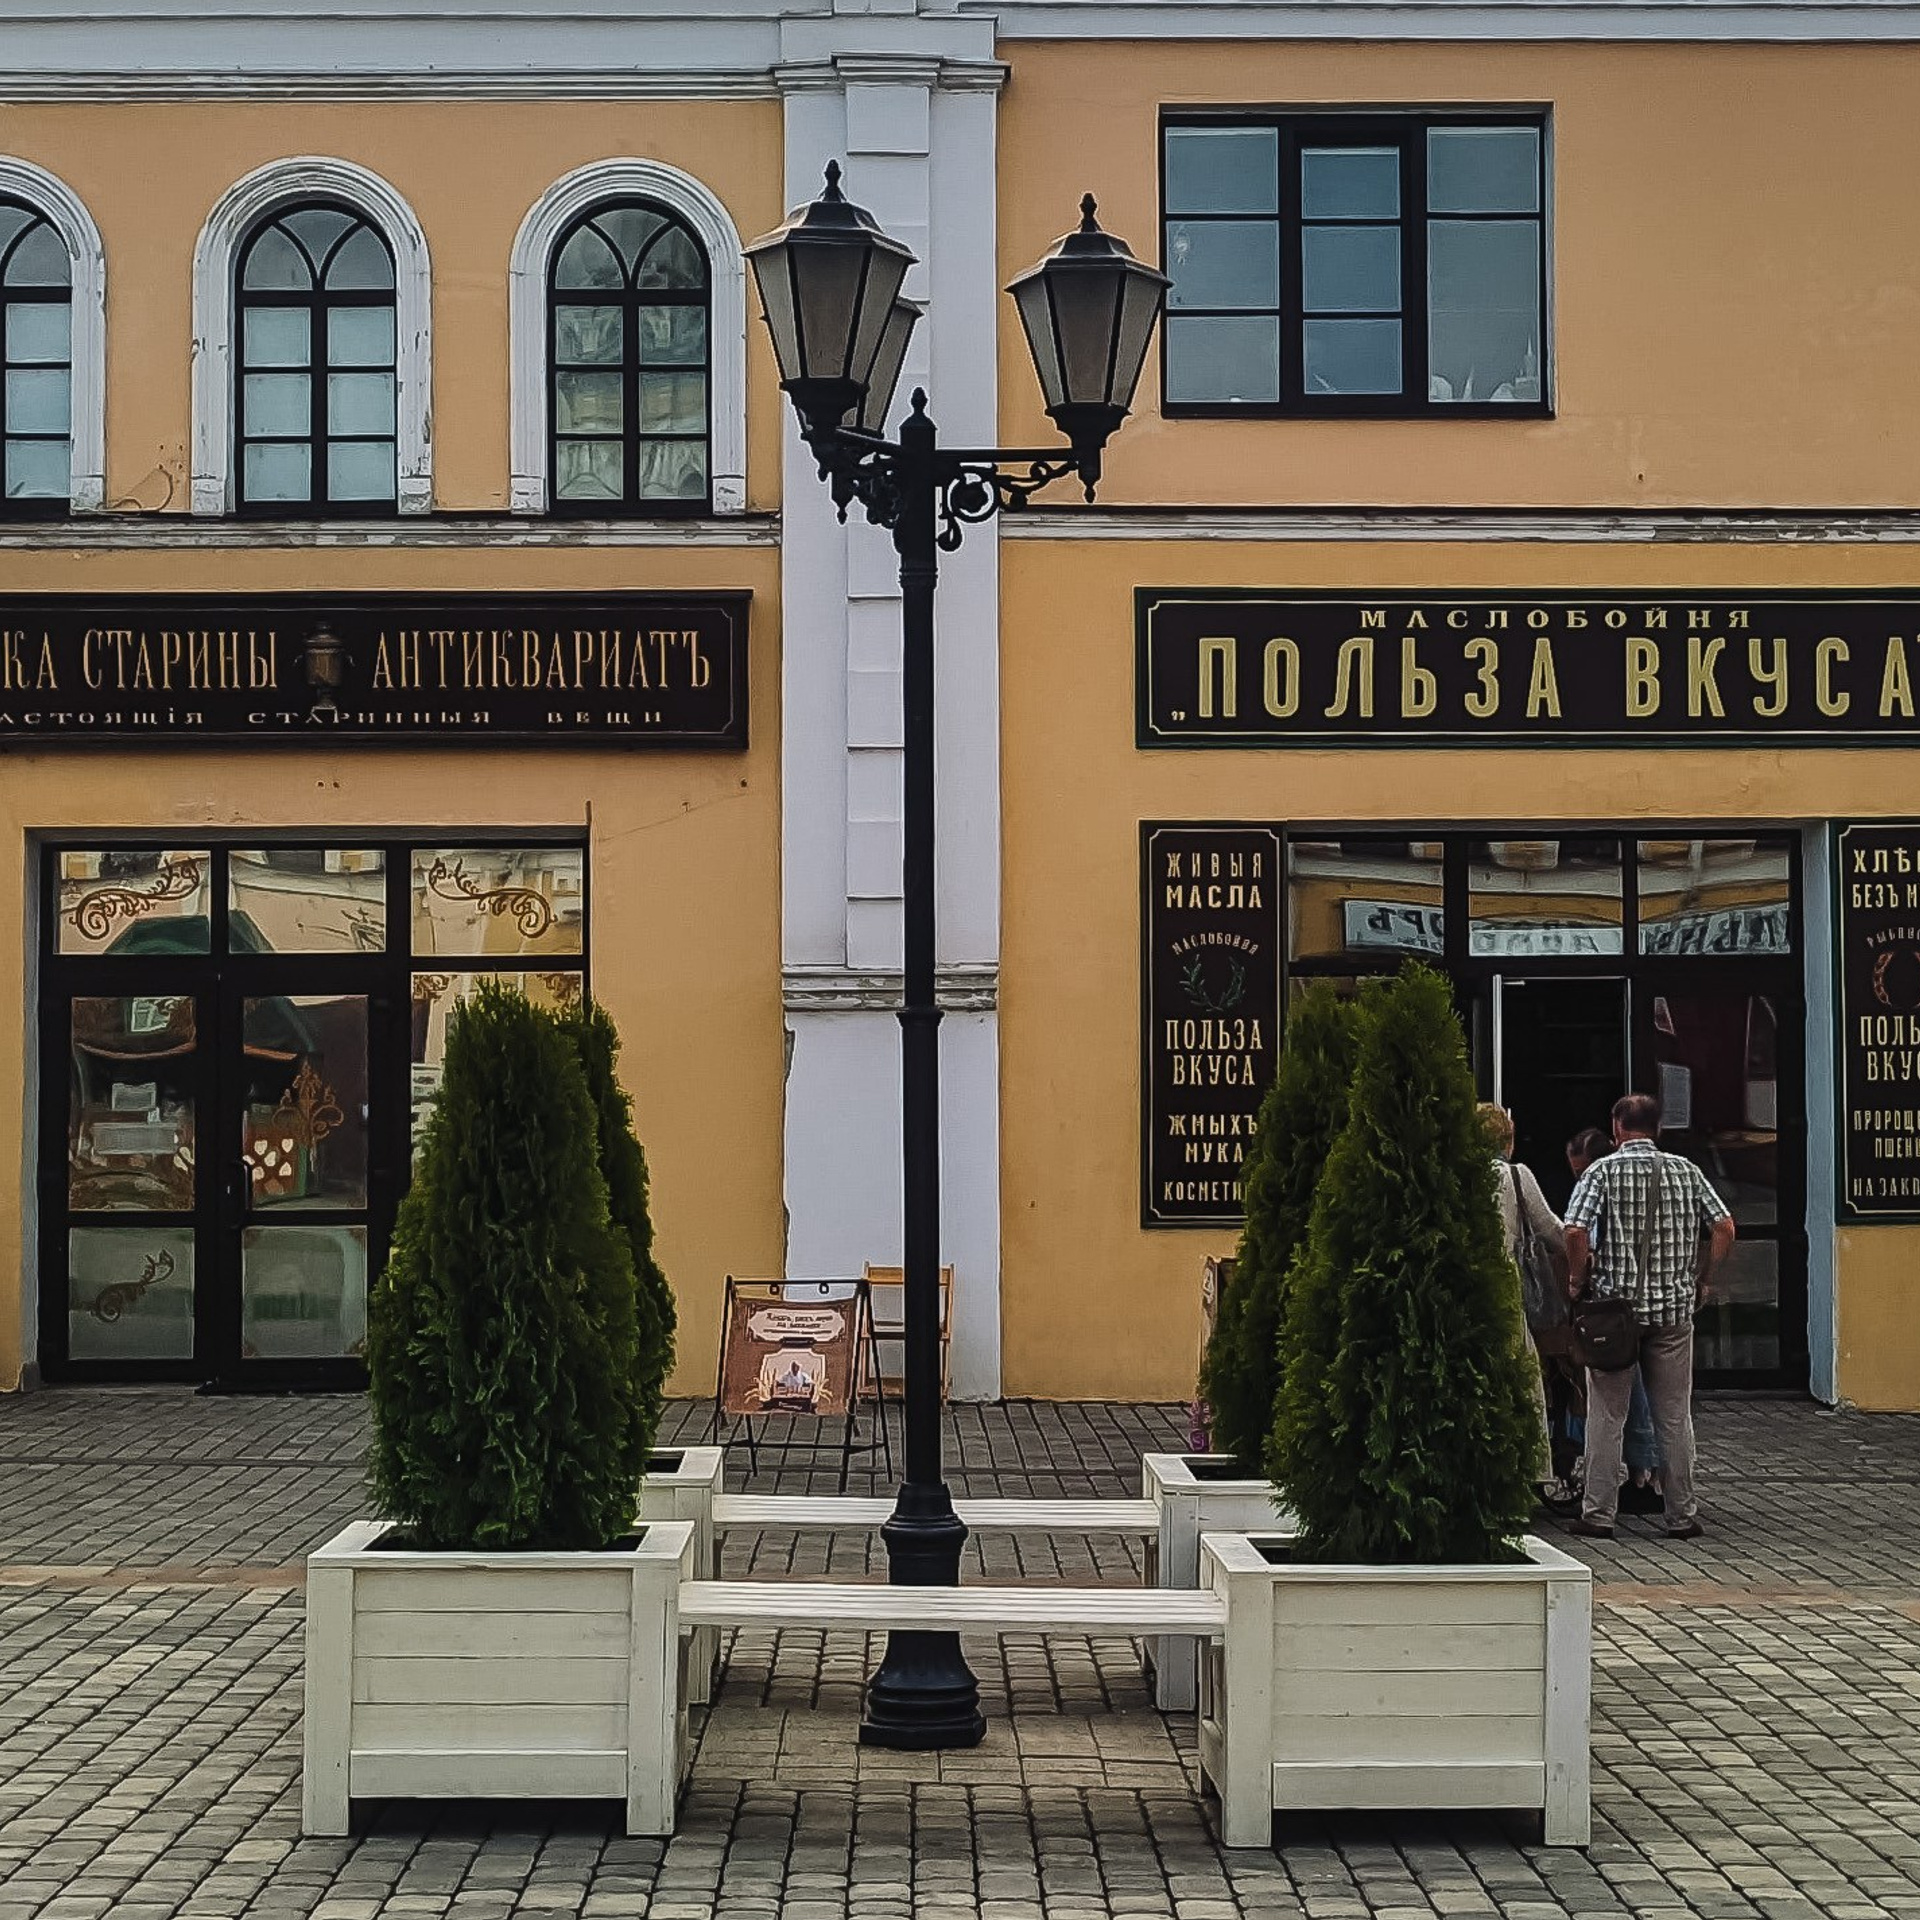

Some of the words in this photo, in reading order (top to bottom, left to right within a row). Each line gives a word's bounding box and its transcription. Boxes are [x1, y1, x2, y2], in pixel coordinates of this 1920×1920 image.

[1360, 606, 1750, 629] МАСЛОБОЙНЯ
[3, 630, 58, 690] КА
[82, 628, 278, 690] СТАРИНЫ
[371, 629, 711, 690] АНТИКВАРИАТЪ
[546, 711, 662, 726] ВЕЩИ
[1166, 852, 1263, 879] ЖИВЫЯ
[1165, 884, 1263, 910] МАСЛА
[1851, 883, 1899, 909] БЕЗЪ
[1165, 1018, 1264, 1051] ПОЛЬЗА
[1172, 1053, 1256, 1087] ВКУСА
[1184, 1141, 1244, 1164] МУКА
